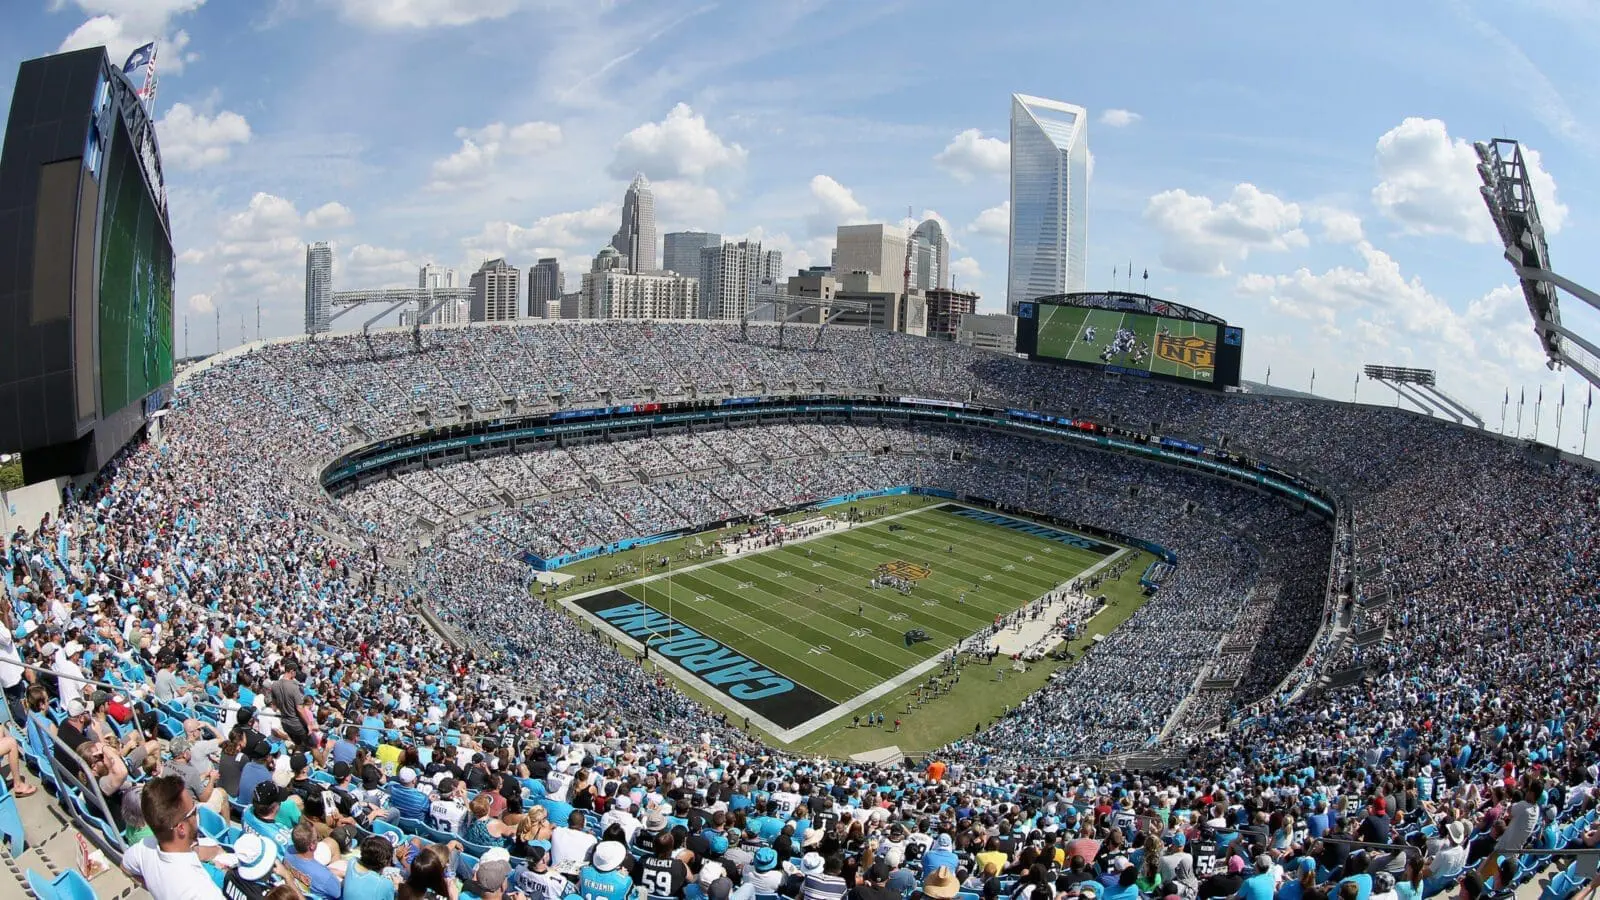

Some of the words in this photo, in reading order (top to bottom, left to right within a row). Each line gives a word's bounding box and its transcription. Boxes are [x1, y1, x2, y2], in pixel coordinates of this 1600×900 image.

[594, 602, 796, 700] CAROLINA
[584, 880, 614, 892] BENJAMIN
[642, 869, 672, 897] 59
